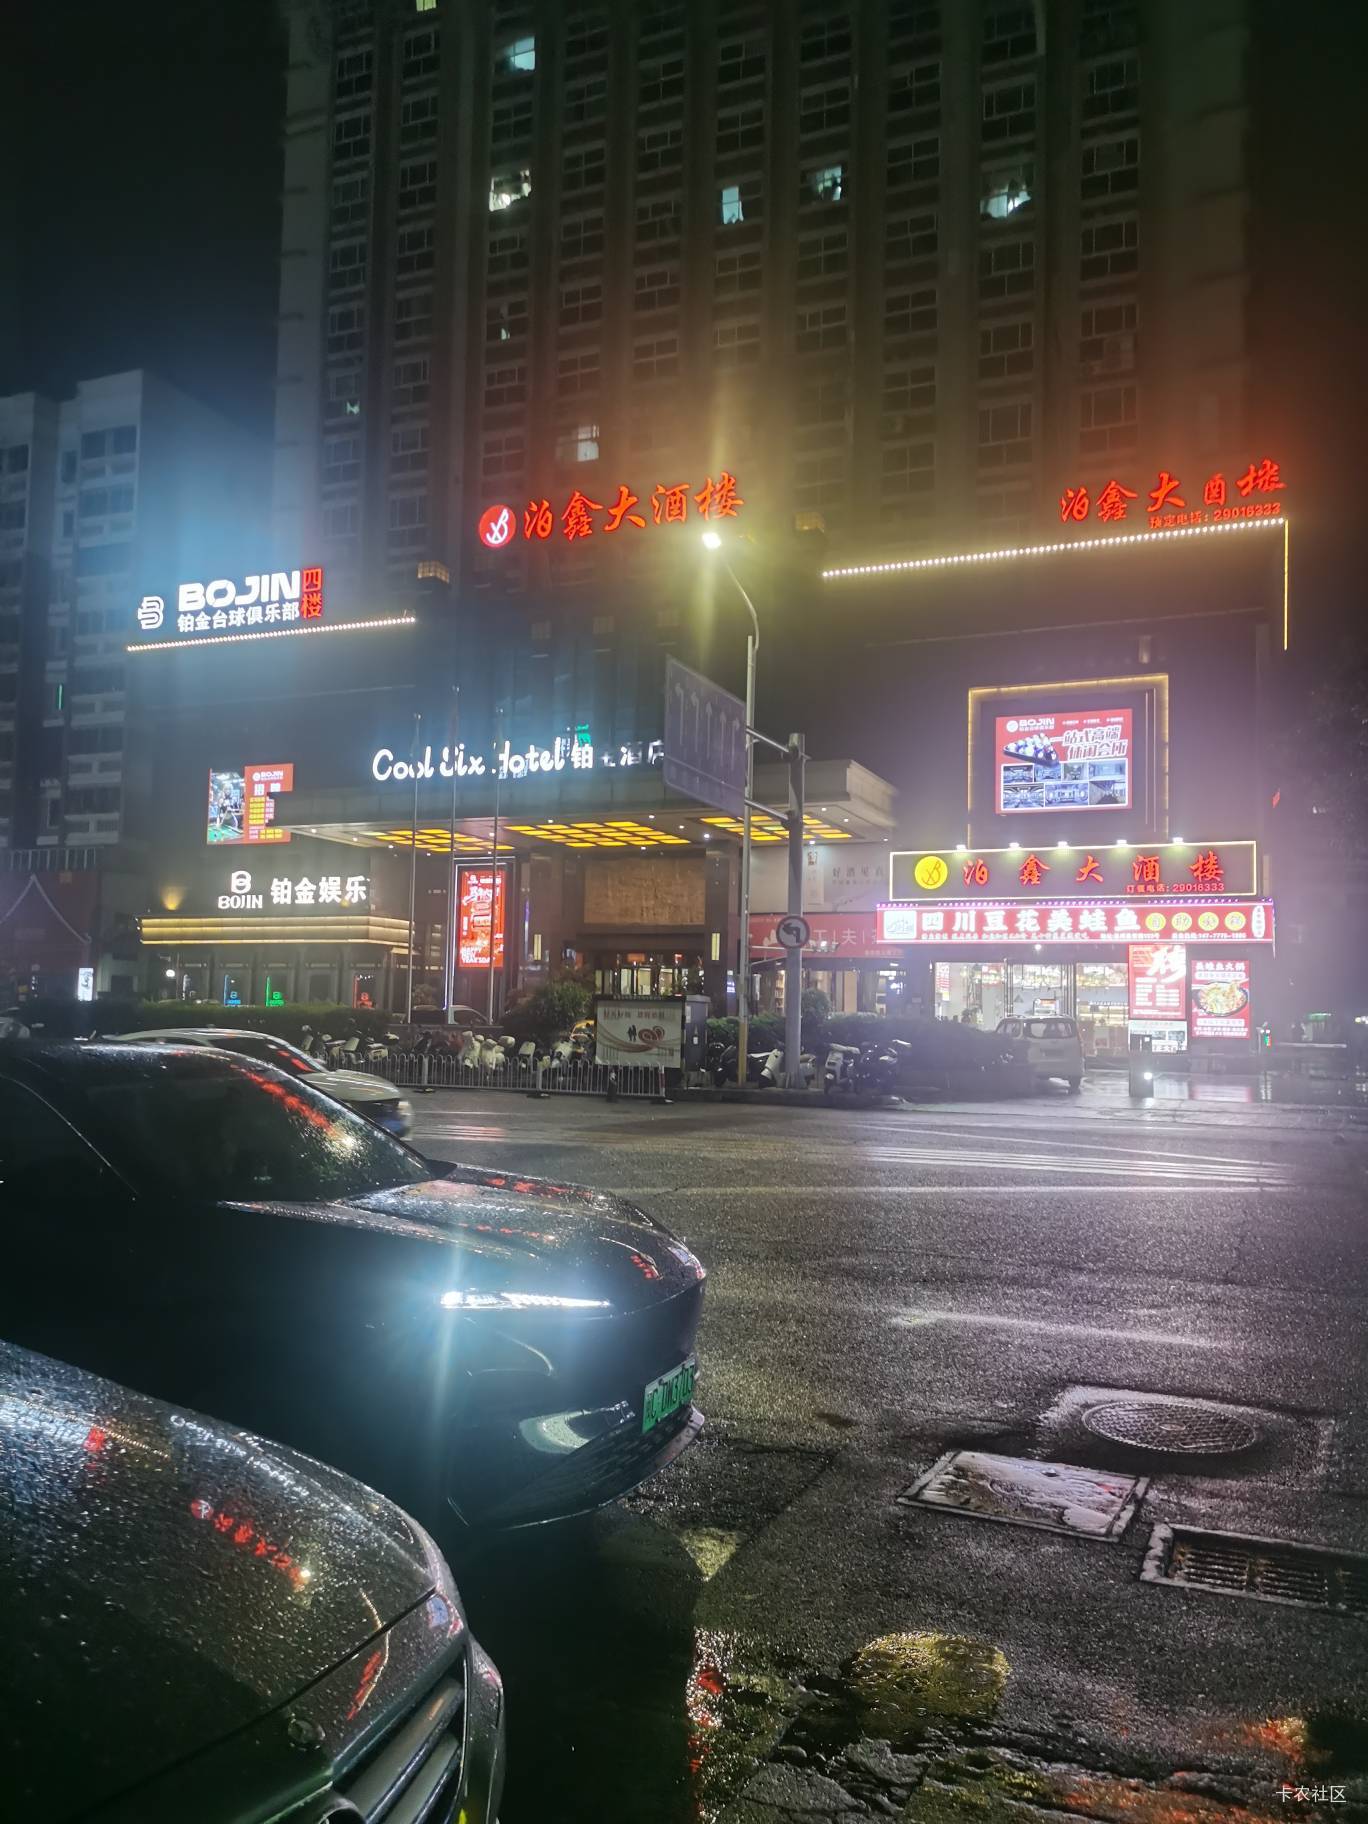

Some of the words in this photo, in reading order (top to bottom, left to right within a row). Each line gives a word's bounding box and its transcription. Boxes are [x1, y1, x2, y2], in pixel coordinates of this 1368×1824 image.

[524, 472, 744, 541] 泊鑫大酒楼
[178, 571, 300, 611] BOJIN
[301, 568, 322, 618] 四楼
[177, 602, 300, 633] 铂金台球俱乐部
[962, 854, 1224, 886] 泊鑫大酒楼
[218, 895, 263, 909] BOJIN
[270, 875, 369, 905] 铂金娱乐
[921, 908, 1141, 932] 四川豆花美蛙鱼
